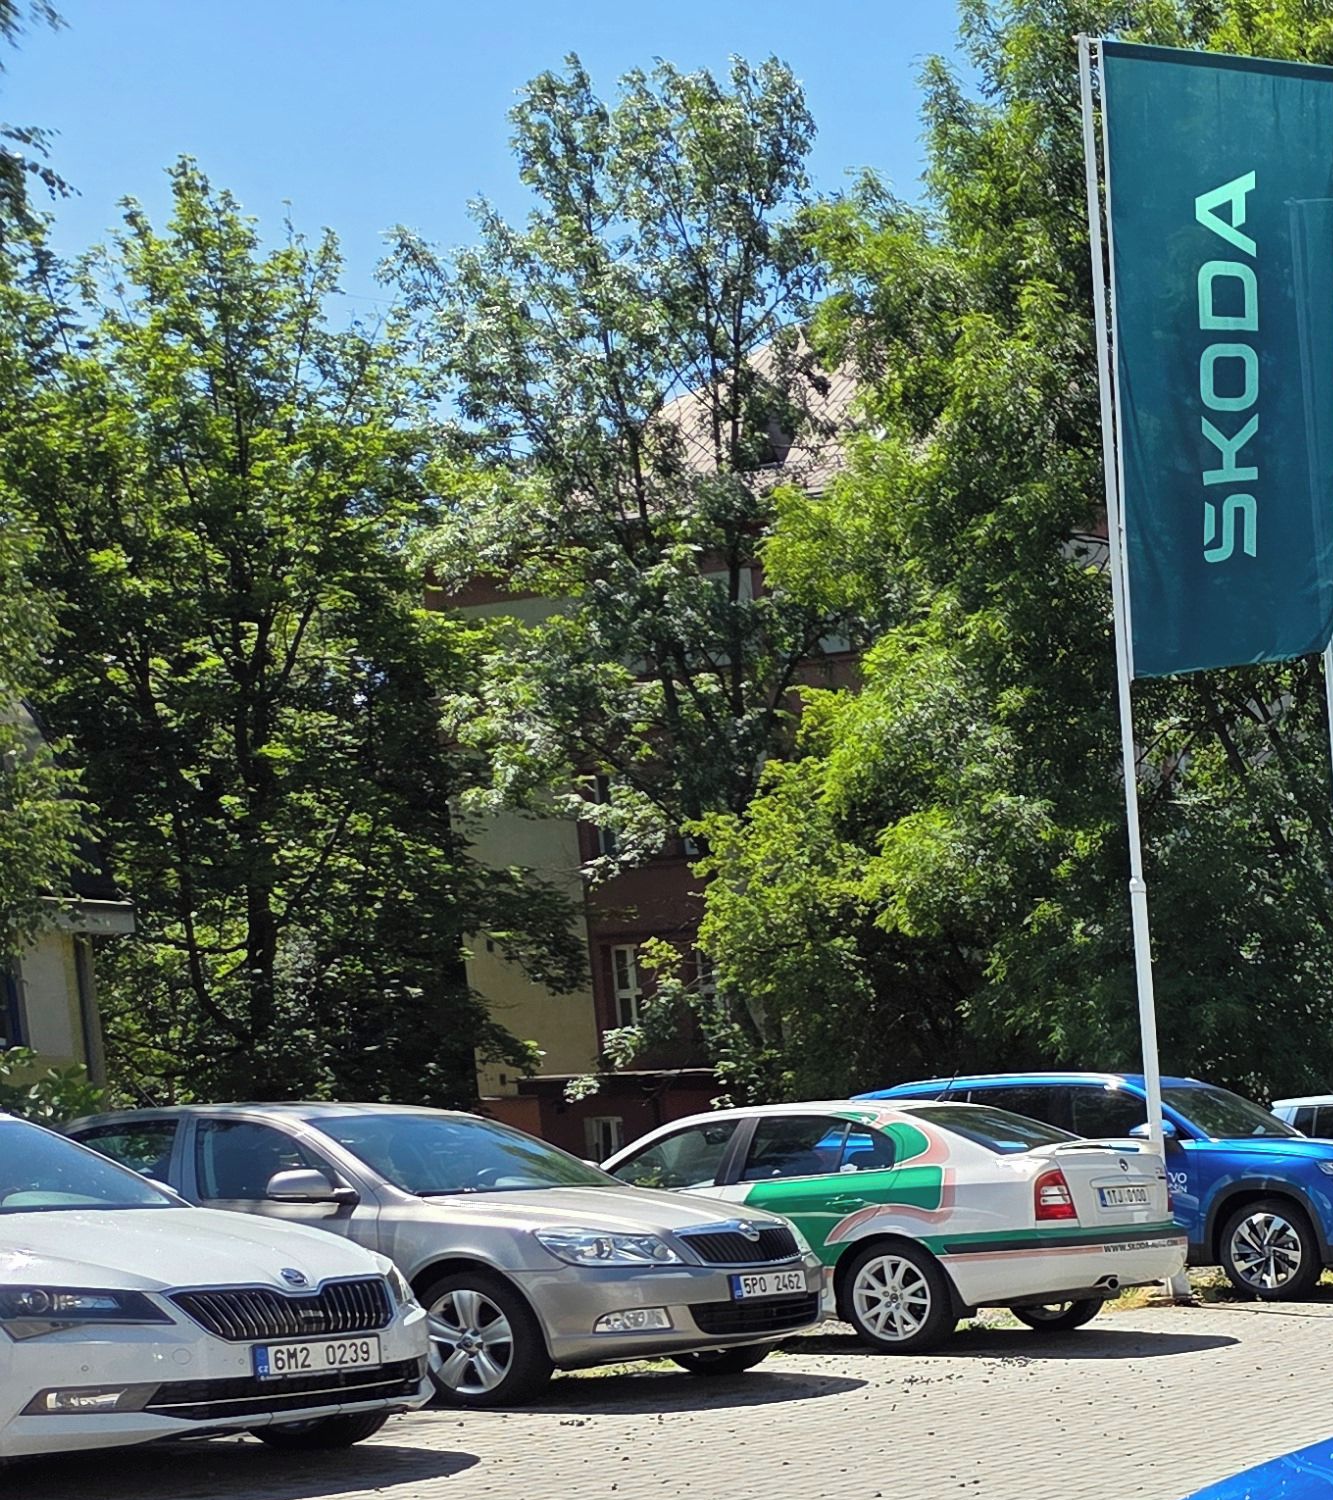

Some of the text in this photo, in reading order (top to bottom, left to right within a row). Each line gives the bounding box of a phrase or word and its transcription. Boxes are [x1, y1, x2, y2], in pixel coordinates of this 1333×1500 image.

[774, 1273, 802, 1291] 2462
[274, 1341, 370, 1371] 6M2 0239
